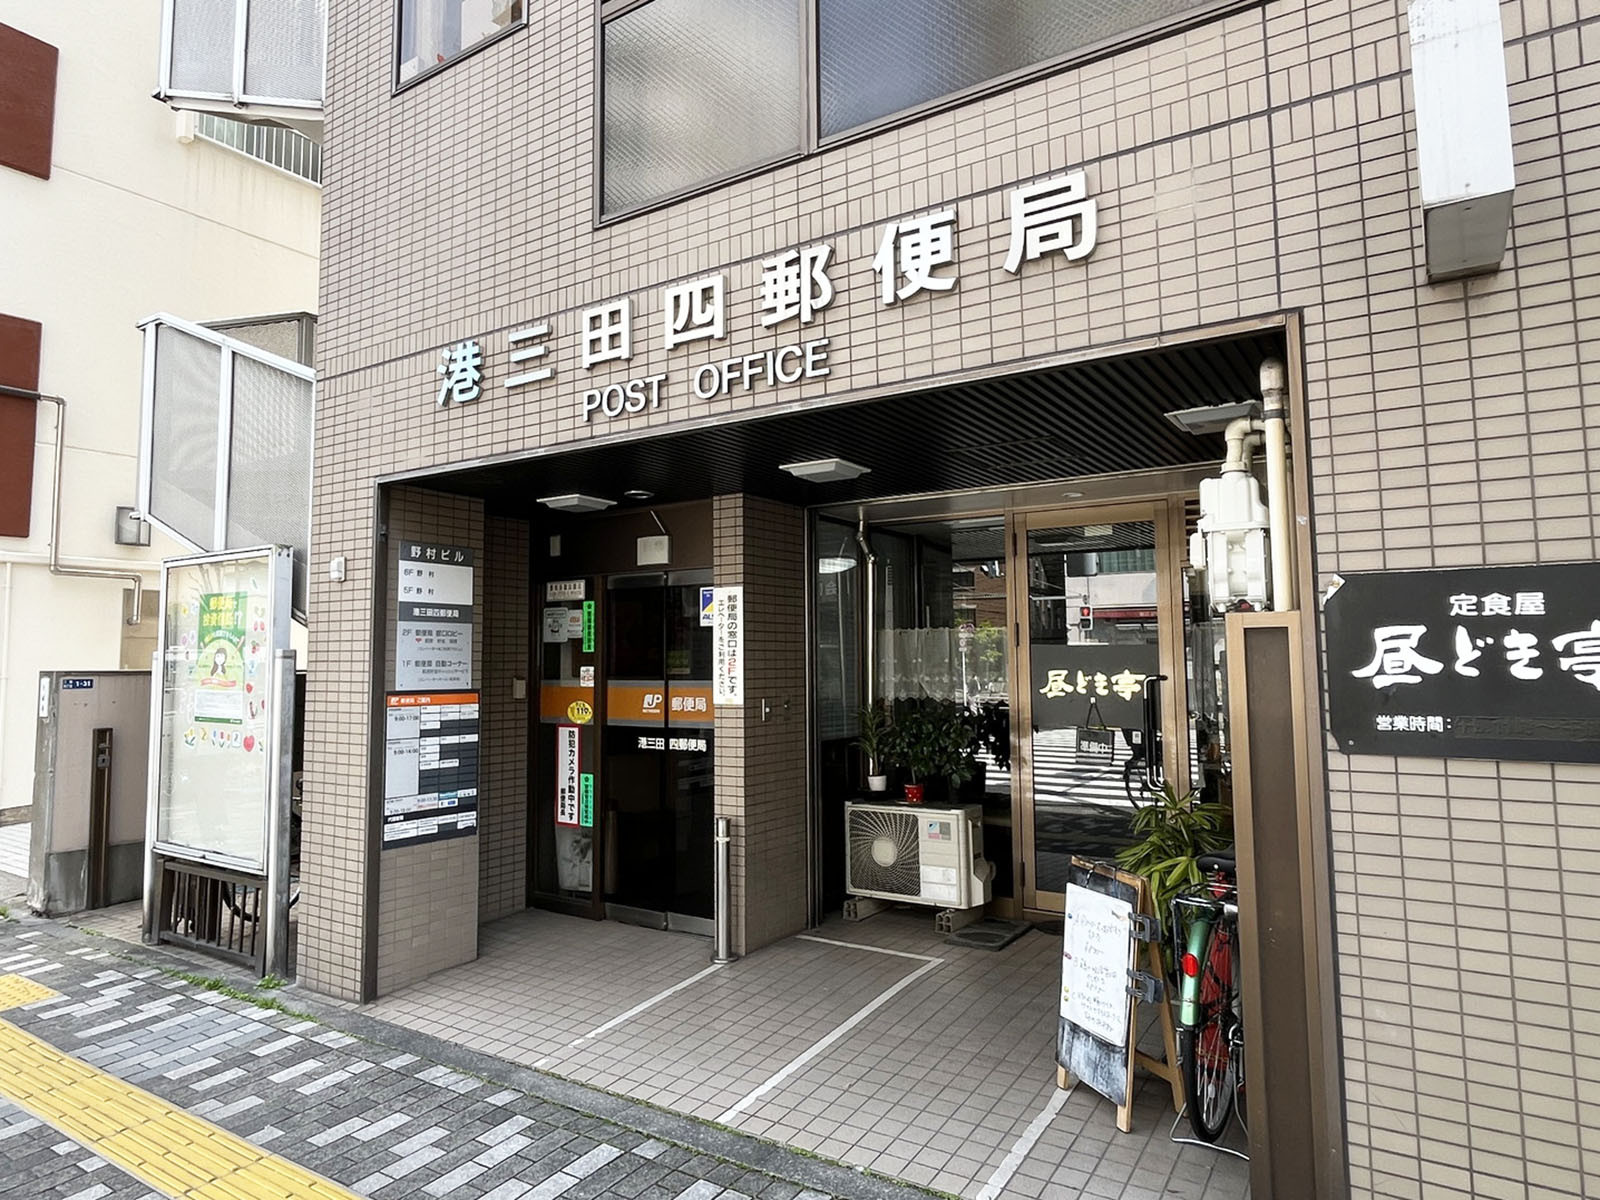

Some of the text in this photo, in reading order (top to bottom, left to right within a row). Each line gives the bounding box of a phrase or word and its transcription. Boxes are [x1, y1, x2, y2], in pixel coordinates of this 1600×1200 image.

[437, 169, 1098, 406] 港三田四郵便局
[584, 338, 830, 422] POST OFFICE
[410, 545, 465, 562] 野村ビル
[1449, 591, 1547, 617] 定食屋
[1039, 668, 1147, 702] 昼どき亭
[671, 696, 707, 713] 郵便局
